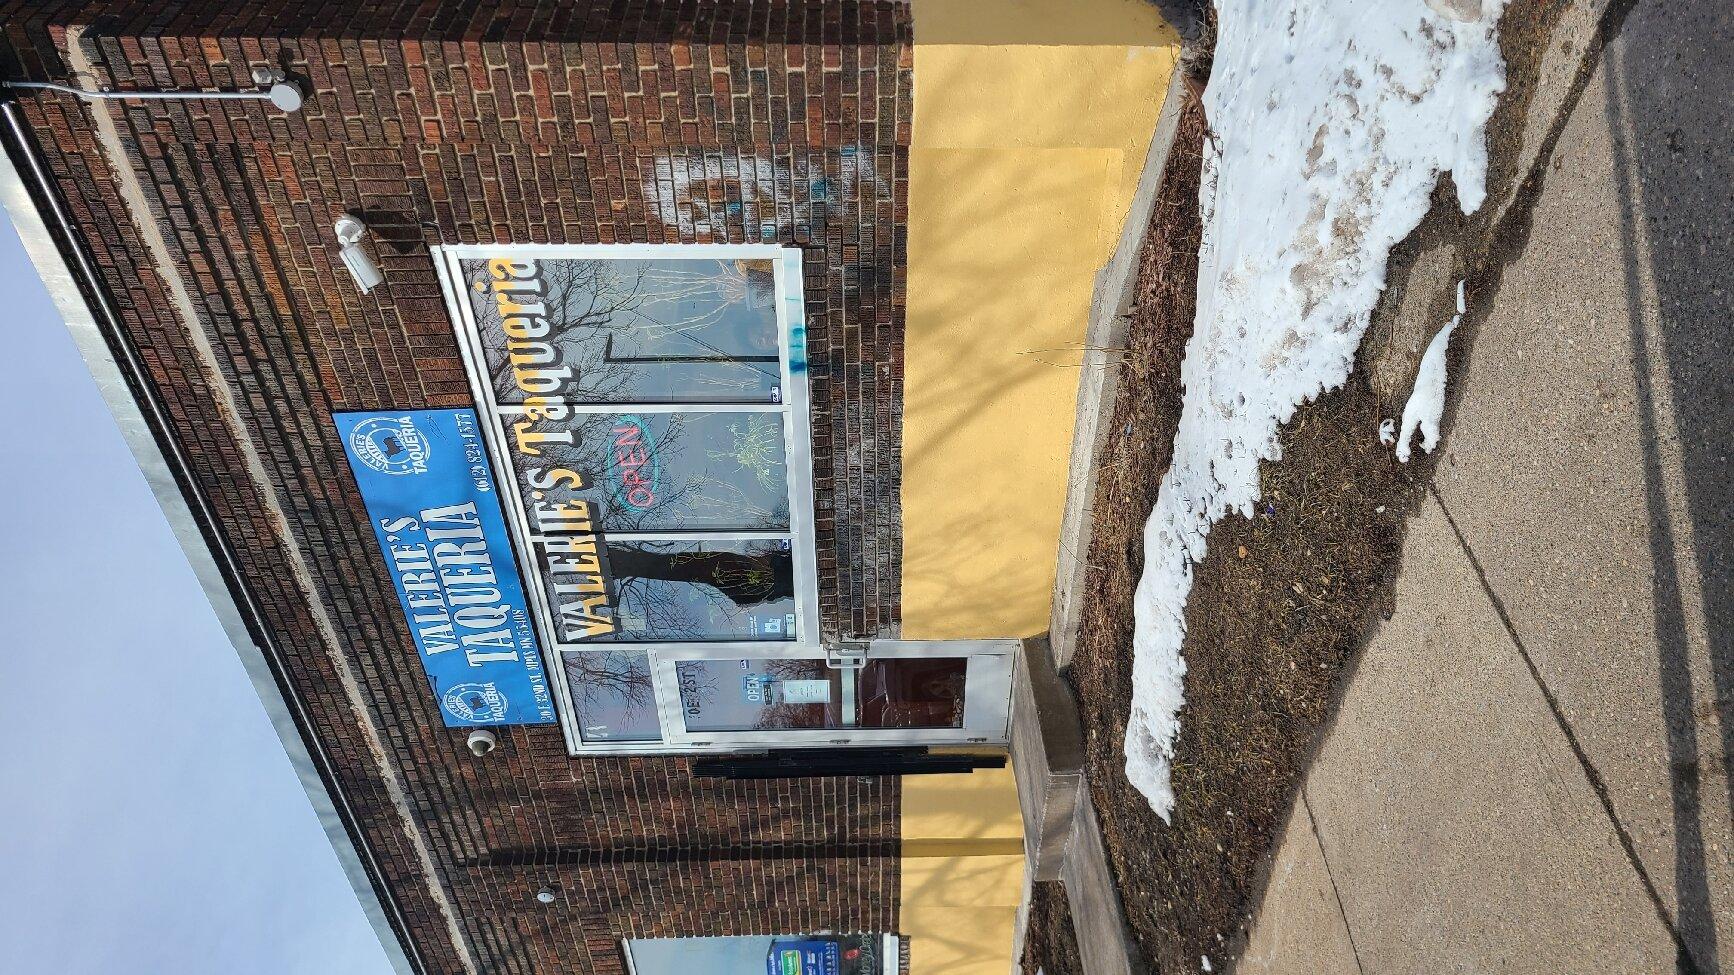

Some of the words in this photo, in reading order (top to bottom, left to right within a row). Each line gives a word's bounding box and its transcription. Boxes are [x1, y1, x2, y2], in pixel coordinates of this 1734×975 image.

[474, 258, 574, 455] Taqueria
[356, 434, 388, 470] VALERIE'S
[399, 416, 427, 474] TAQUERIA
[455, 413, 482, 463] 824-1577
[613, 424, 655, 508] OPEN
[470, 465, 491, 492] (612)
[525, 467, 616, 641] VALERIE'S
[380, 516, 460, 656] VALERIE'S
[420, 501, 519, 667] TAQUERIA
[482, 682, 505, 722] TAQUERIA
[746, 677, 760, 701] OPEN
